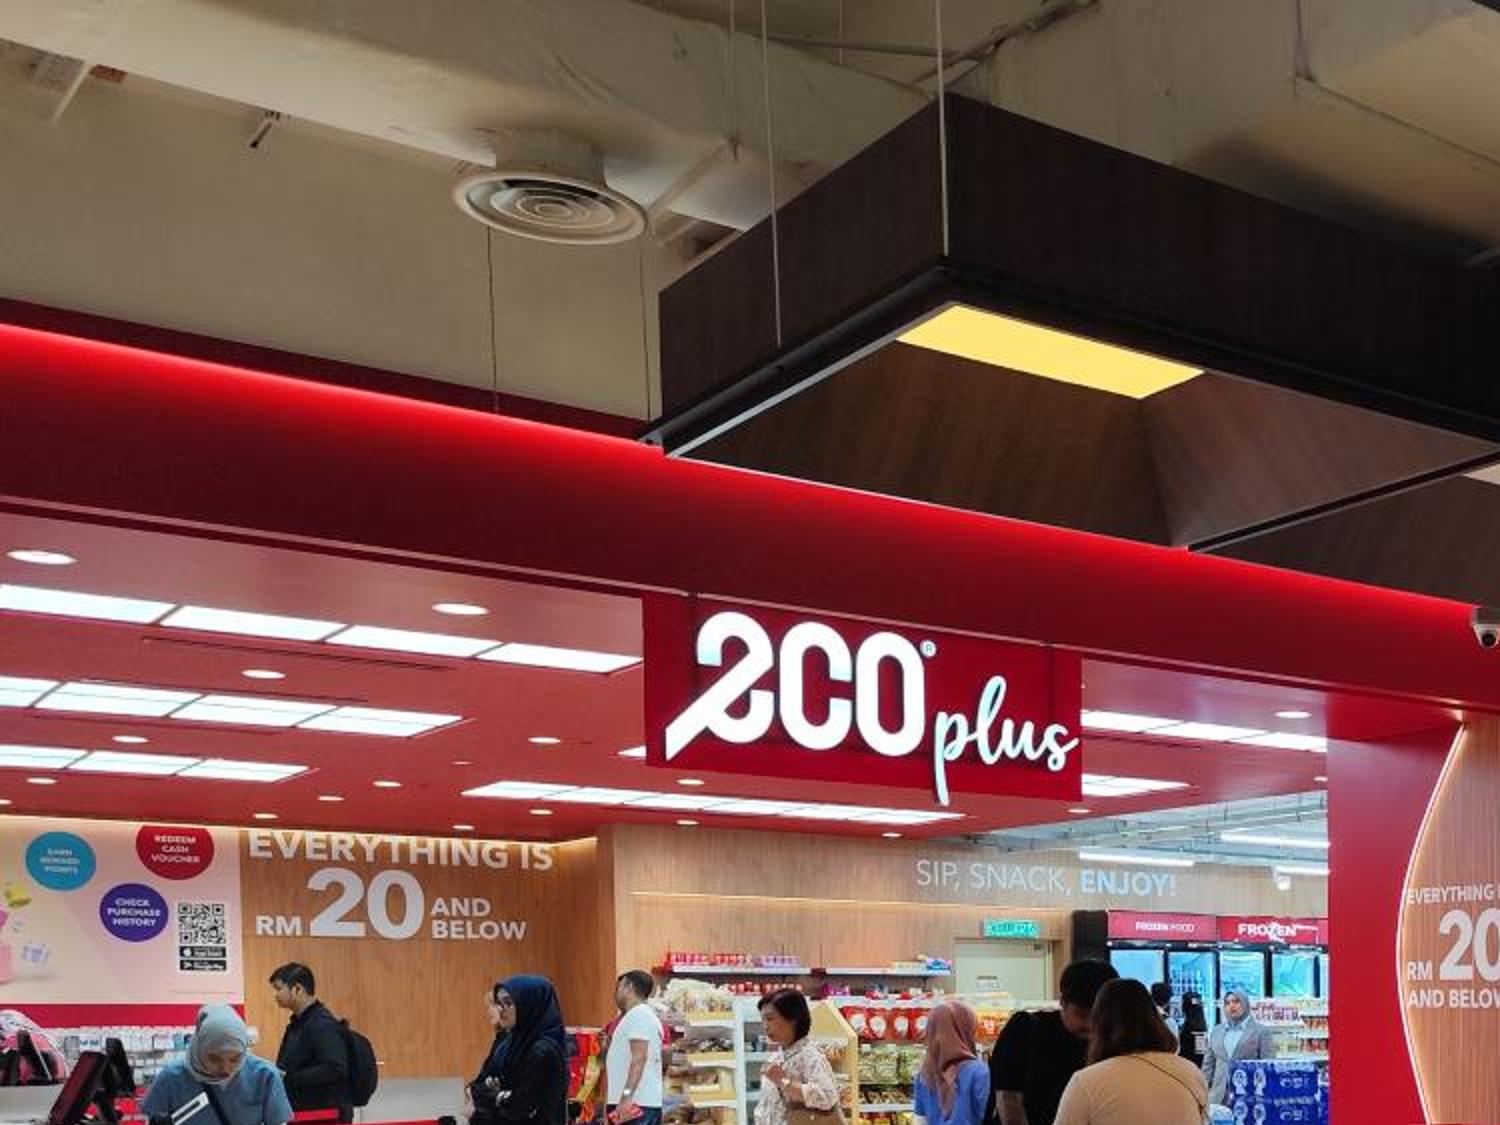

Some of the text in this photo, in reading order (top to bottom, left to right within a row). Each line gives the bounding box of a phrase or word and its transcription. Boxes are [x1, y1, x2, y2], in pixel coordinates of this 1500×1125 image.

[934, 675, 1078, 806] plus
[249, 832, 553, 871] EVERYTHING IS
[915, 860, 1177, 897] SIP, SNACK, ENJOY!
[256, 867, 425, 940] RM 20
[1407, 884, 1496, 904] EVERYTHING
[107, 908, 160, 917] PURCHASE
[431, 897, 490, 916] AND
[112, 918, 157, 927] HISTORY
[432, 920, 526, 940] BELOW
[1407, 960, 1433, 980] RM
[1408, 989, 1444, 1008] AND
